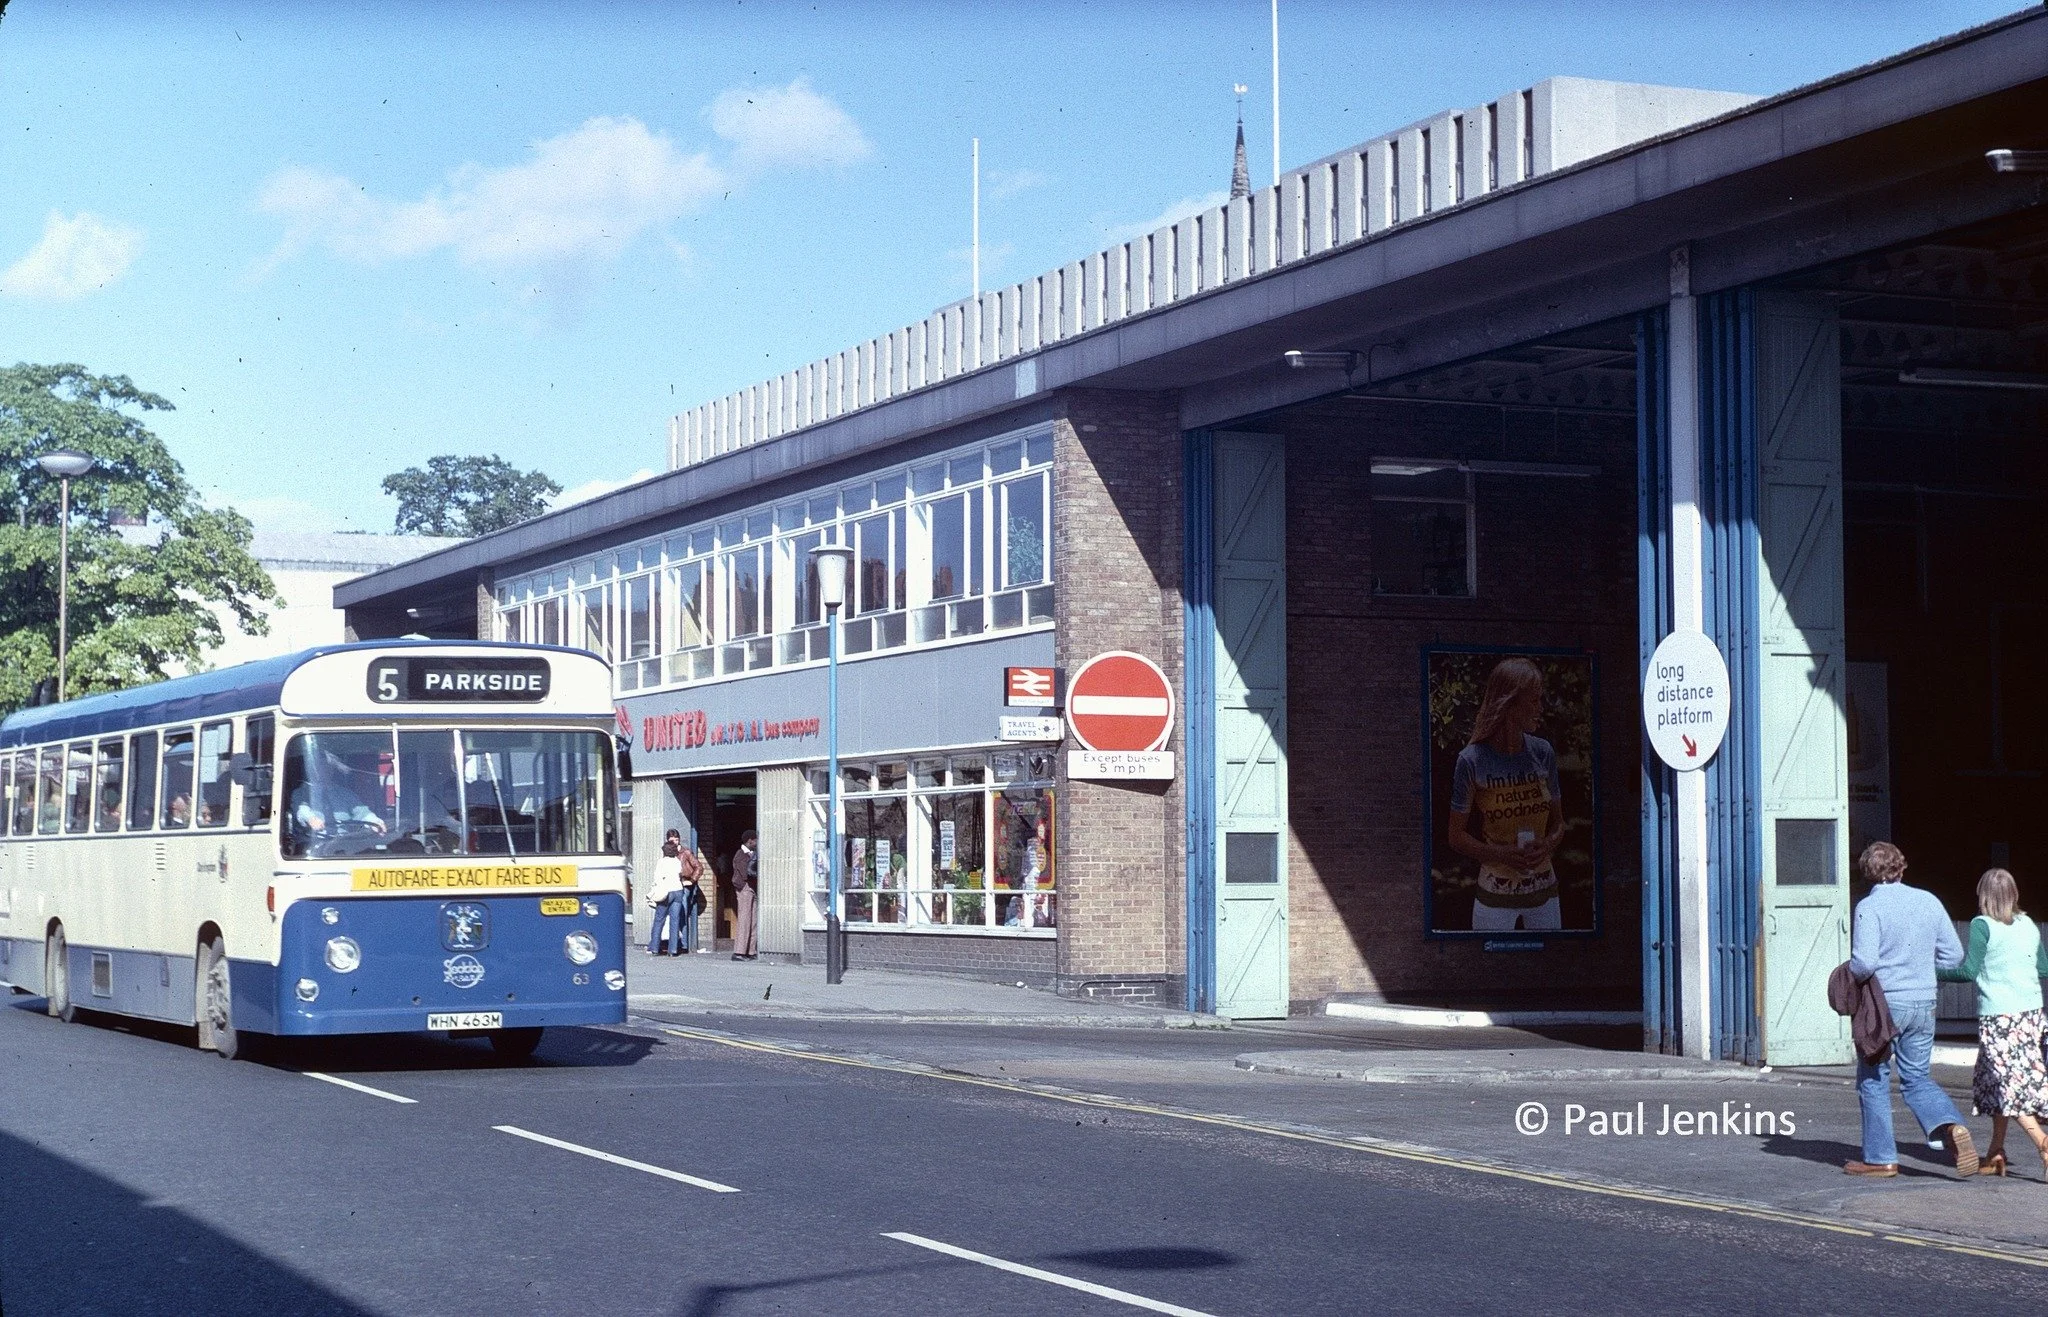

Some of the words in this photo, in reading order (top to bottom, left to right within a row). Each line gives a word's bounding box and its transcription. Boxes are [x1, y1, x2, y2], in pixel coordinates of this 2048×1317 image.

[1656, 661, 1684, 682] long
[378, 668, 399, 700] 5
[425, 673, 542, 691] PARKSIDE
[1657, 685, 1714, 702] distance
[1657, 706, 1713, 730] platform
[643, 709, 707, 753] UNITED
[764, 718, 780, 741] bus
[781, 717, 820, 742] company
[1083, 753, 1122, 764] Except
[1127, 753, 1161, 763] buses
[1100, 764, 1107, 773] 5
[1114, 764, 1146, 774] mph
[1486, 773, 1505, 789] I'm
[1506, 771, 1527, 788] full
[1496, 784, 1543, 803] natural
[496, 868, 530, 885] FARE
[535, 867, 562, 884] BUS
[572, 973, 590, 985] 63
[430, 1016, 458, 1028] WHN
[462, 1014, 501, 1027] 463M
